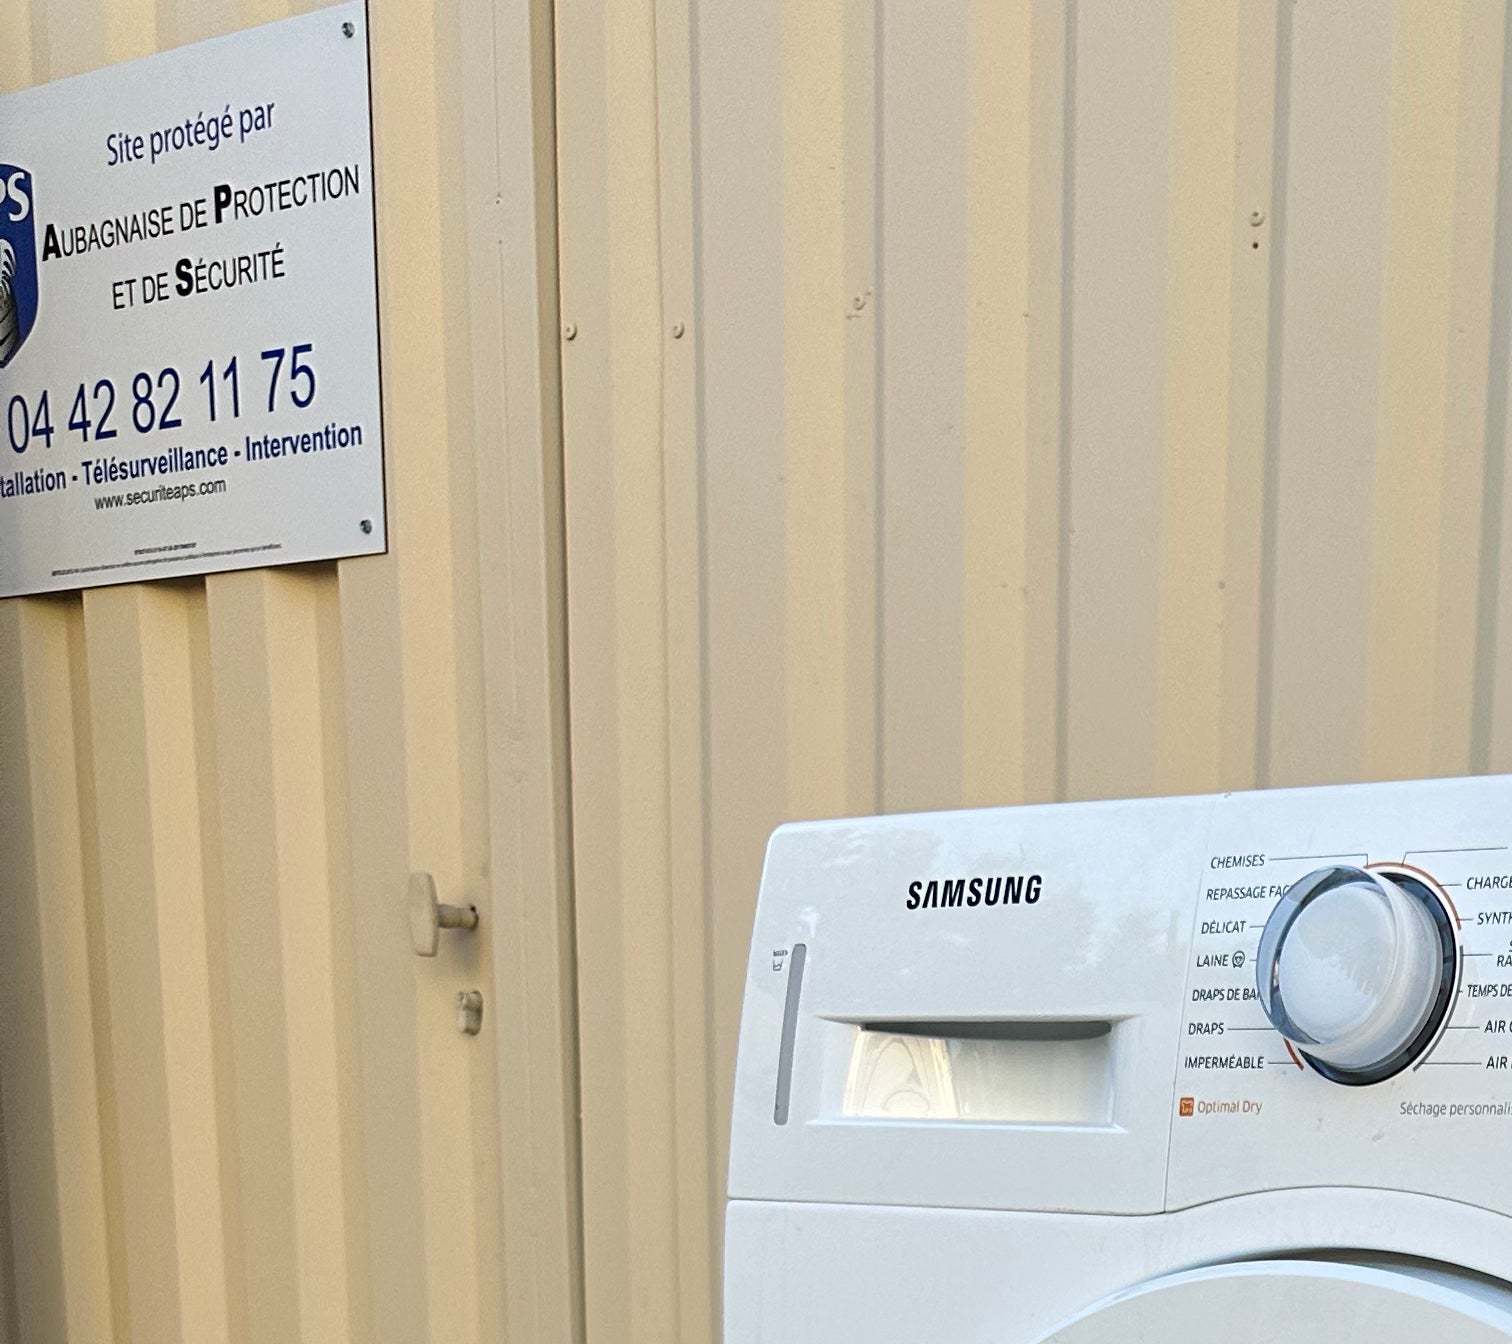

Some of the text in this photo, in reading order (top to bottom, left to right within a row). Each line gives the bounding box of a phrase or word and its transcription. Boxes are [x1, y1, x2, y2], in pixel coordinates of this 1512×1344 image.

[106, 100, 275, 166] Site protégé par
[42, 165, 360, 262] AUBAGNAISE DE PROTECTION
[112, 242, 285, 309] ET DE SÉCURITÉ
[8, 343, 316, 454] 04 42 82 11 75
[0, 468, 66, 498] tallation
[82, 444, 228, 485] Télésurveillance
[246, 422, 362, 462] Intervention
[94, 478, 226, 510] www.securiteaps.com
[1211, 854, 1265, 869] CHEMISES
[906, 875, 1043, 910] SAMSUNG
[1206, 884, 1290, 900] REPASSAGE FAC
[1201, 920, 1246, 934] DÉLICAT
[1196, 954, 1229, 967] LAINE
[1192, 988, 1259, 1001] DRAPS DE BA
[1467, 984, 1498, 997] TEMPS
[1500, 984, 1512, 997] DE
[1188, 1022, 1224, 1035] DRAPS
[1484, 1020, 1506, 1033] AIR
[1184, 1054, 1264, 1069] IMPERMÉABLE
[1486, 1056, 1507, 1069] AIR
[1198, 1100, 1262, 1115] Optimal Dry
[1400, 1101, 1447, 1117] Séchage
